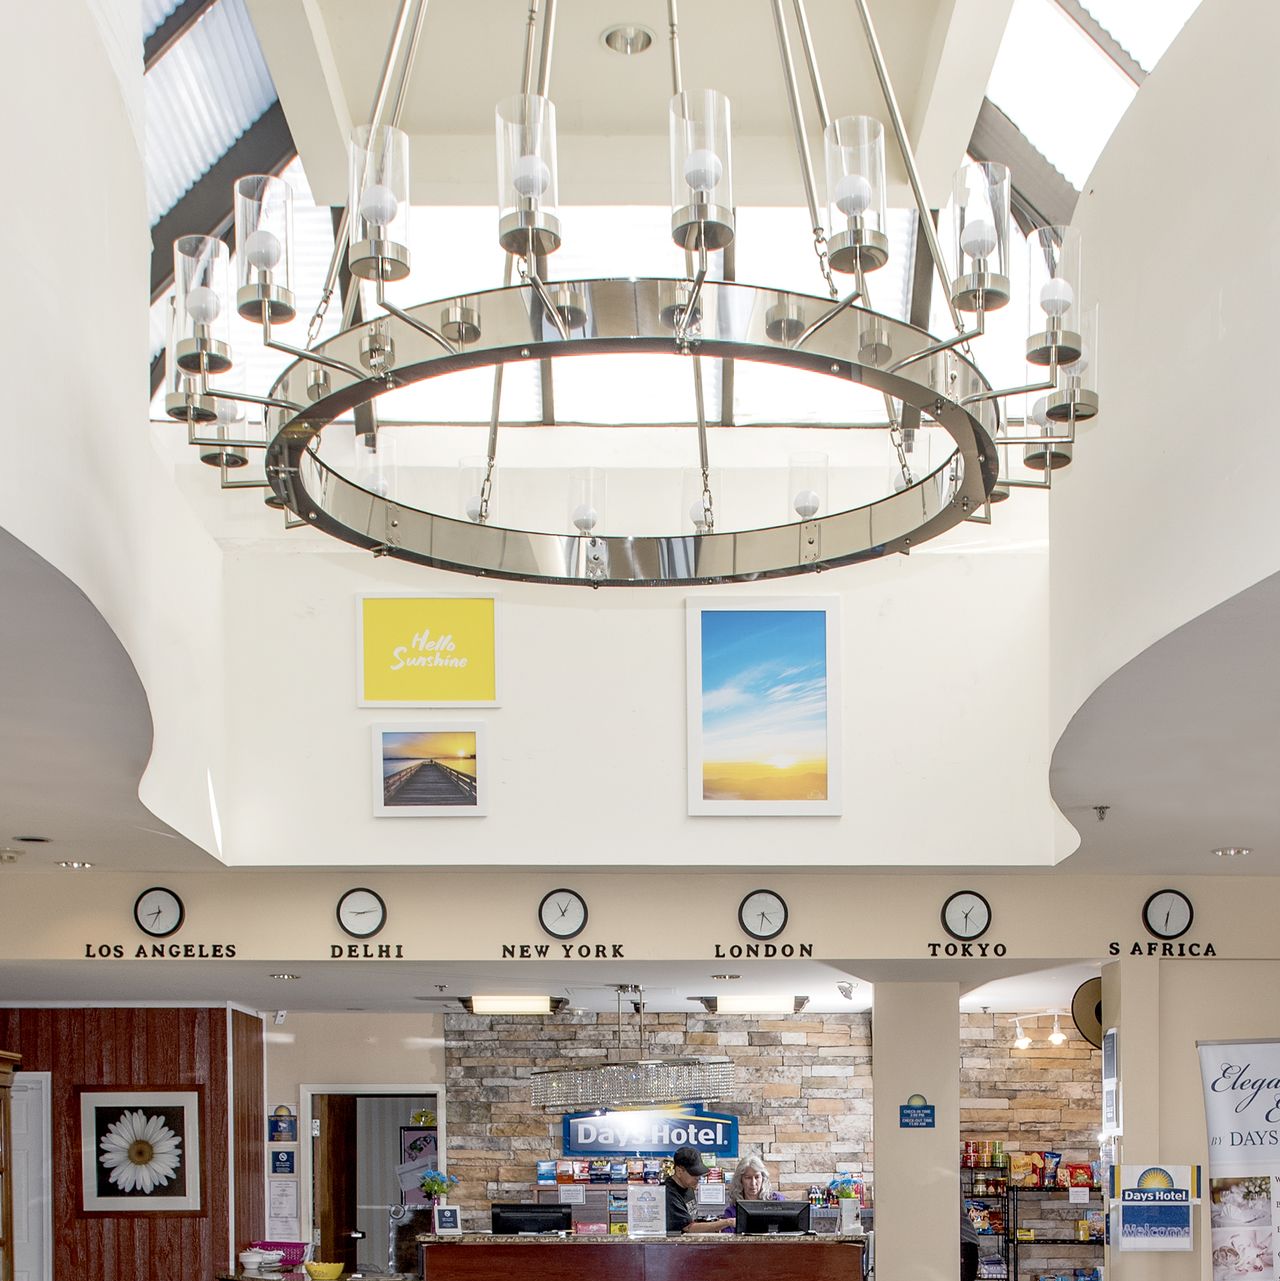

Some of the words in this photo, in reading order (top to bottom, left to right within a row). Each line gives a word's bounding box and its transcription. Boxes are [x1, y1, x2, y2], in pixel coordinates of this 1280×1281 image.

[411, 628, 456, 652] Hello
[389, 646, 469, 671] Sunshine
[84, 943, 125, 959] LOS
[134, 943, 238, 959] ANGELES
[330, 944, 405, 959] DELHI
[502, 944, 549, 959] NEW
[562, 944, 626, 959] YORK
[715, 943, 814, 958] LONDON
[927, 943, 1008, 957] TOKYO
[1108, 942, 1121, 956] S
[1130, 942, 1218, 957] AFRICA
[577, 1123, 646, 1147] Days
[651, 1123, 724, 1145] Hotel
[1230, 1130, 1279, 1146] DAYS
[1124, 1191, 1154, 1202] Days
[1155, 1191, 1186, 1200] Hotel
